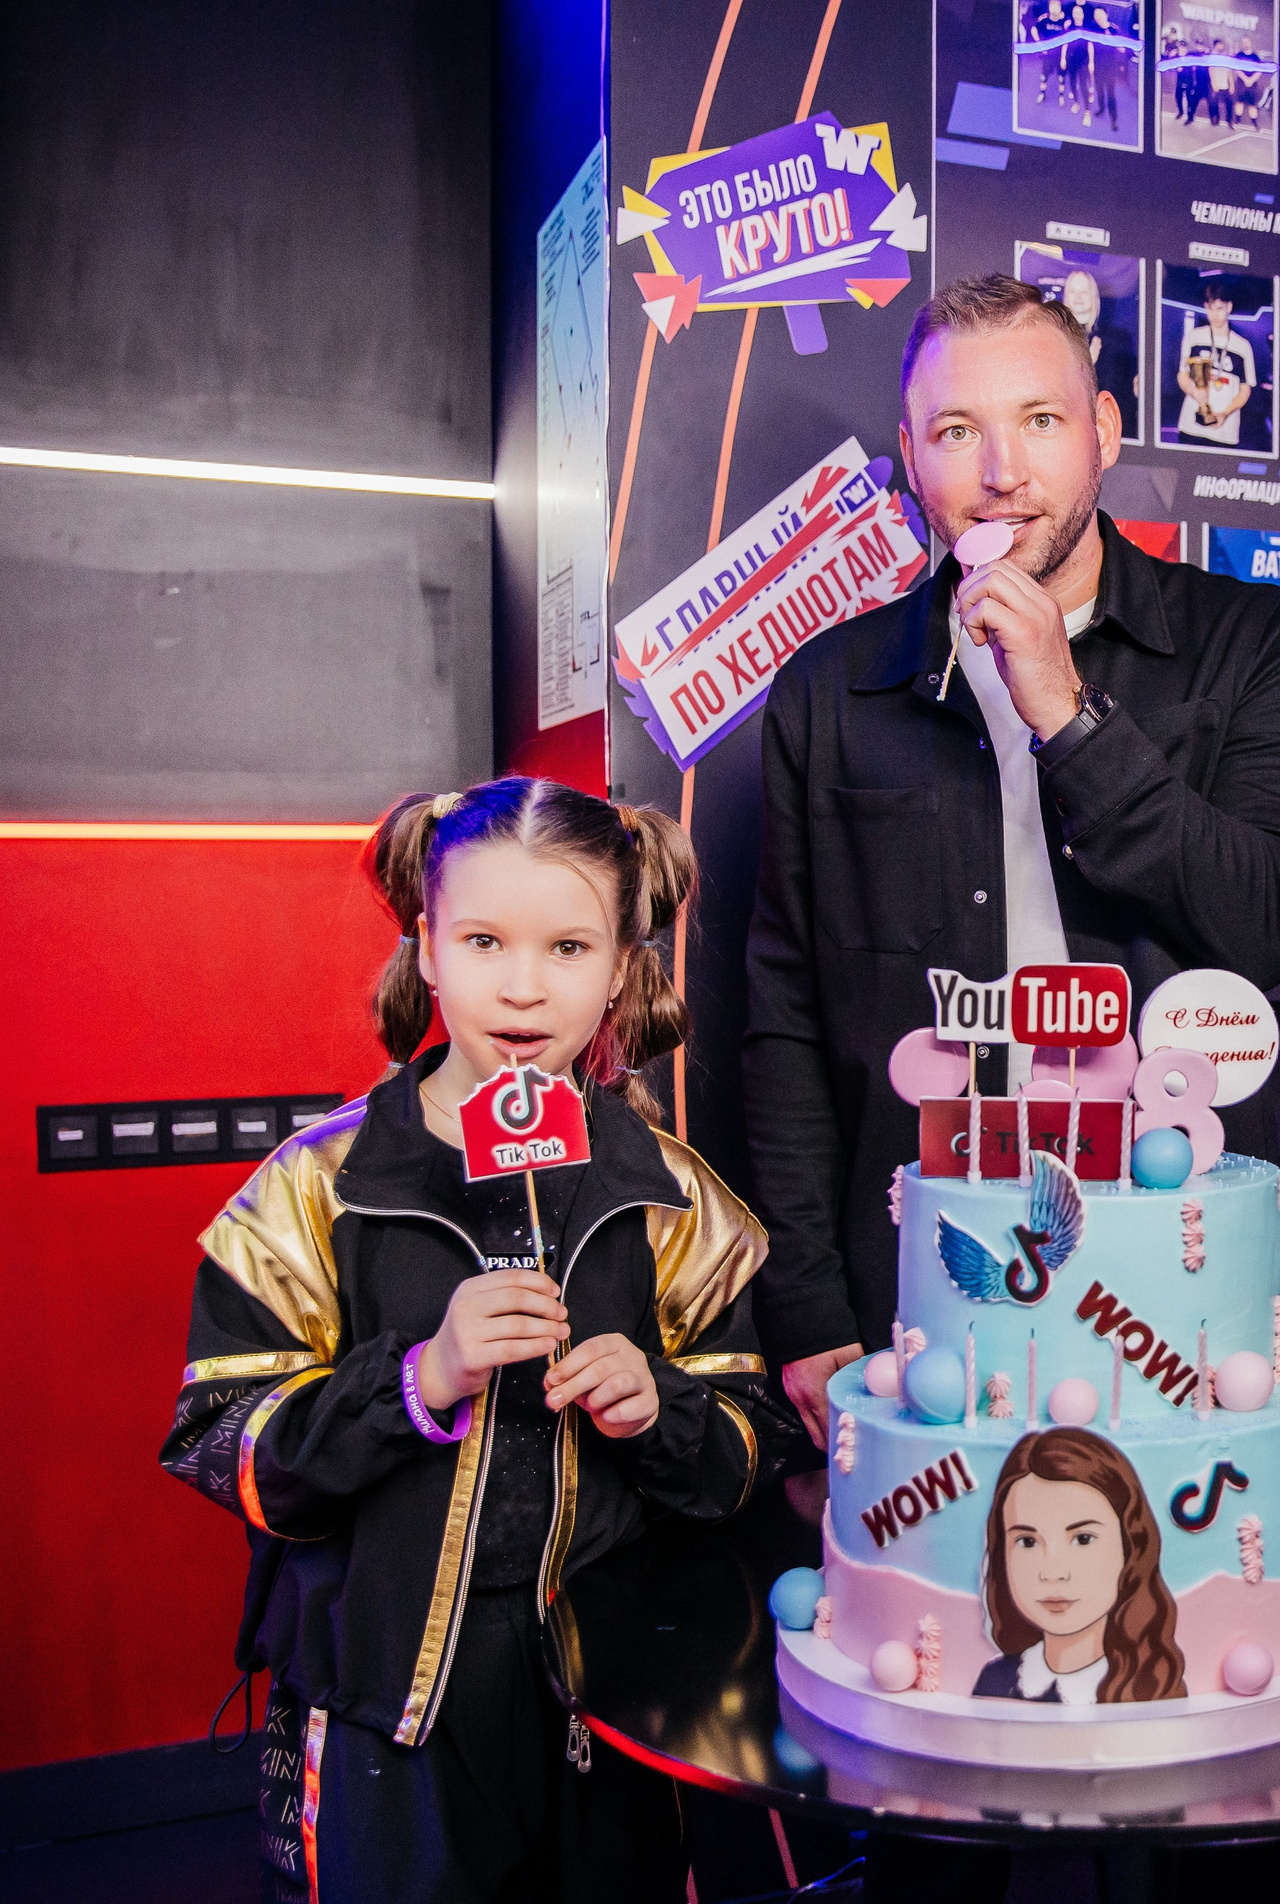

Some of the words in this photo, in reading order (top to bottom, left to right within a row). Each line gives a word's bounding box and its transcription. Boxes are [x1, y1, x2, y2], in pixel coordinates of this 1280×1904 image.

[679, 180, 733, 230] ЭТО
[734, 153, 818, 215] БЫЛО
[1191, 200, 1274, 233] ЧЕМПИОНЫ
[716, 187, 853, 280] КРУТО!
[669, 669, 726, 735] ПО
[716, 522, 899, 696] ХЕДШОТАМ
[932, 973, 1121, 1036] YouTube
[1195, 1006, 1261, 1028] Днём
[496, 1146, 526, 1165] Tik
[529, 1140, 563, 1159] Tok
[1075, 1279, 1200, 1407] WOW!
[405, 1363, 415, 1383] лет
[406, 1385, 416, 1393] 8
[408, 1393, 436, 1434] Милана
[860, 1448, 975, 1547] WOW!
